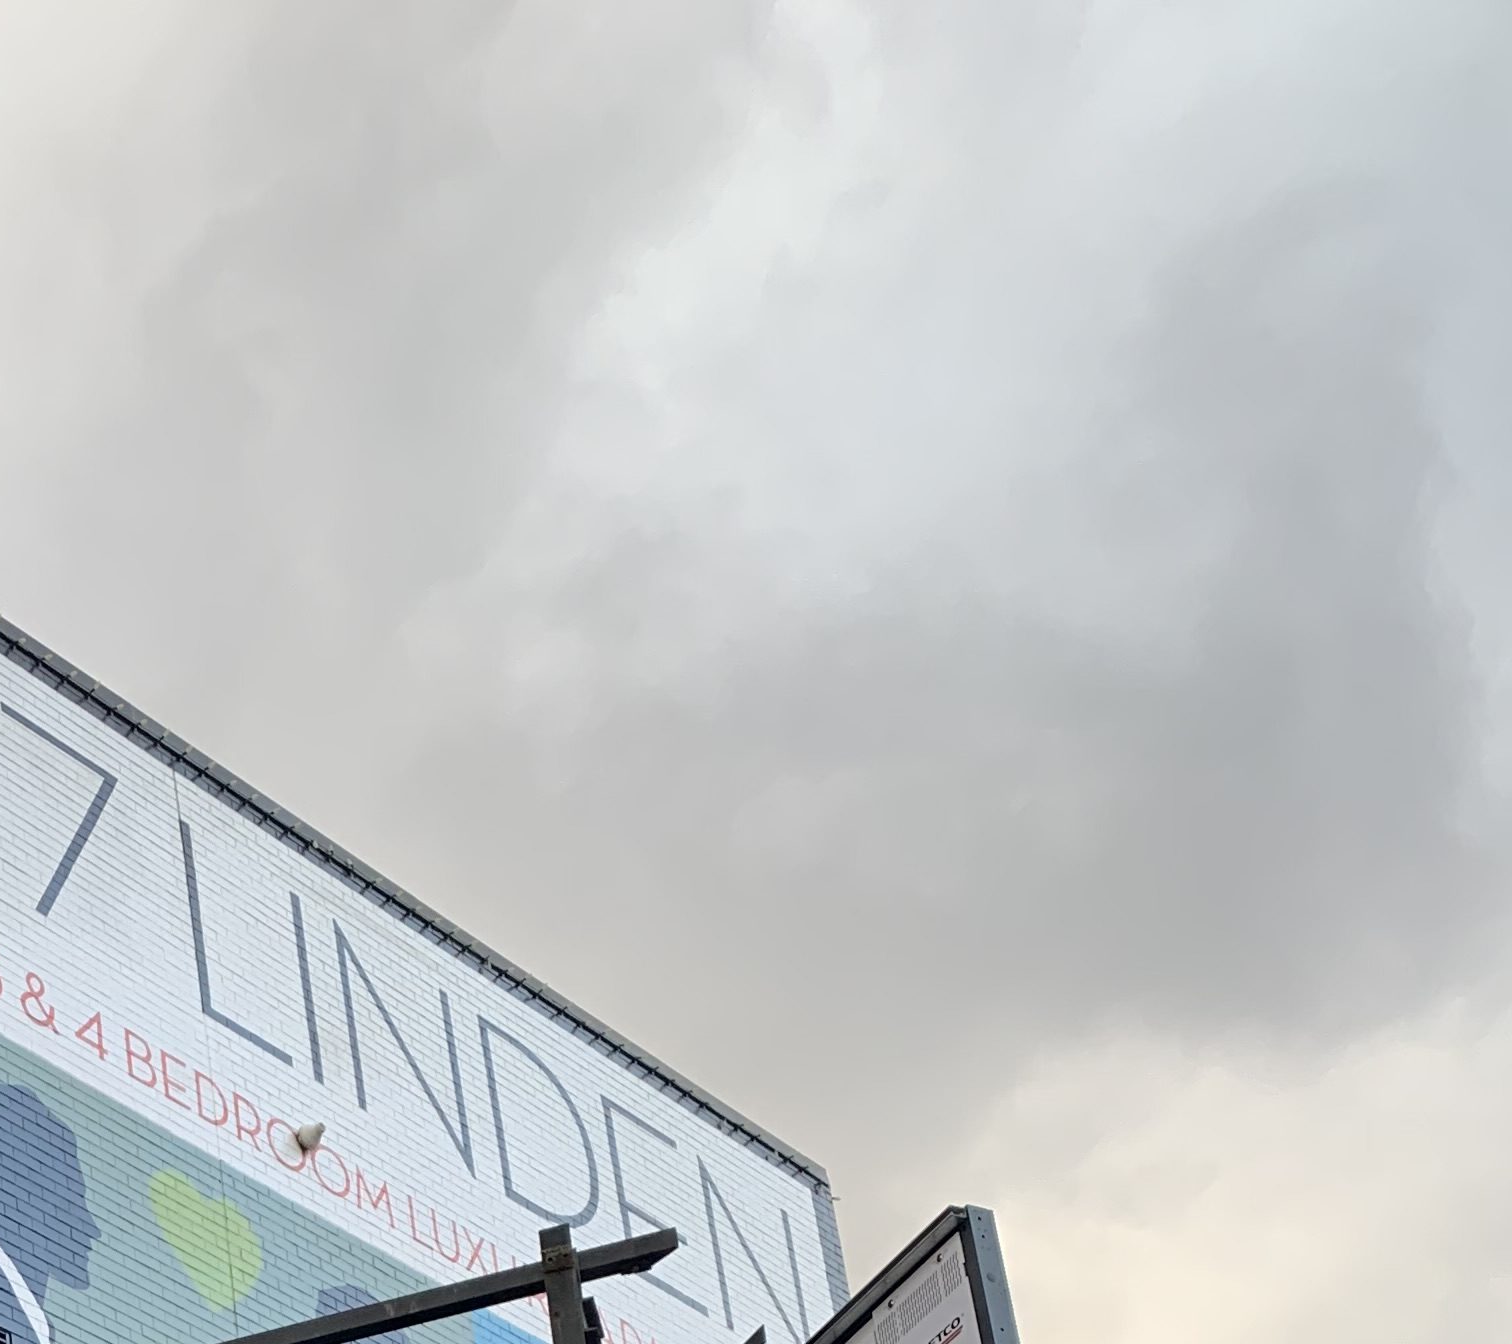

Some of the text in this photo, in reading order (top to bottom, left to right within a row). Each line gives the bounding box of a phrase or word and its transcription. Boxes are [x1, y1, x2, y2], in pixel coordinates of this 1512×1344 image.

[20, 972, 59, 1035] &
[75, 1011, 109, 1061] 4
[124, 1027, 395, 1228] BEDROOM
